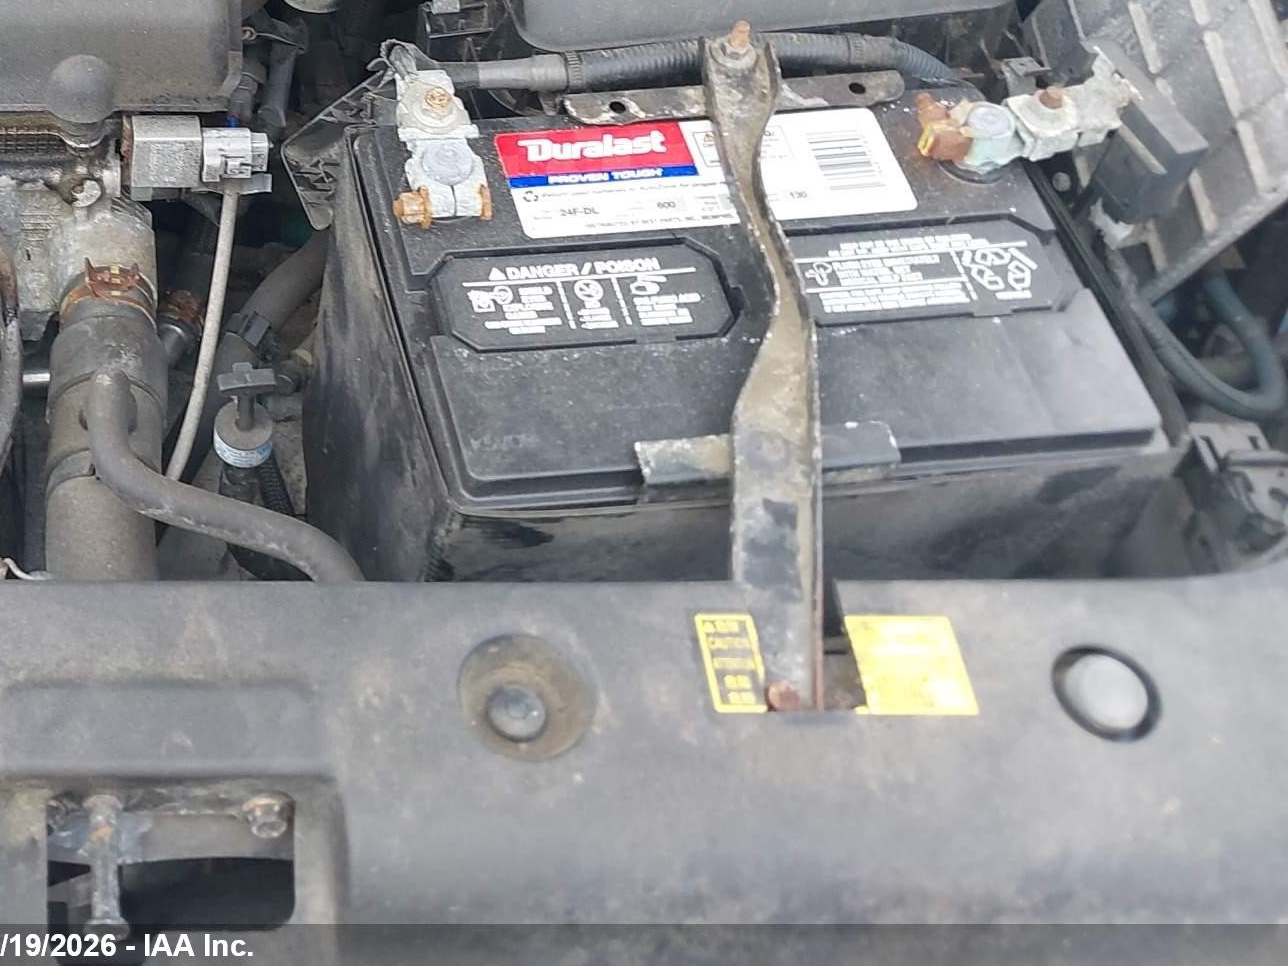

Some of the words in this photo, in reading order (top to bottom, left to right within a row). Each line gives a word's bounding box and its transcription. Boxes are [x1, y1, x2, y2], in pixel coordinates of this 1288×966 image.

[517, 130, 668, 162] Duralast
[547, 171, 610, 185] PROVEN
[611, 167, 664, 181] TOUGH
[505, 262, 579, 280] DANGER
[594, 257, 662, 274] POISON
